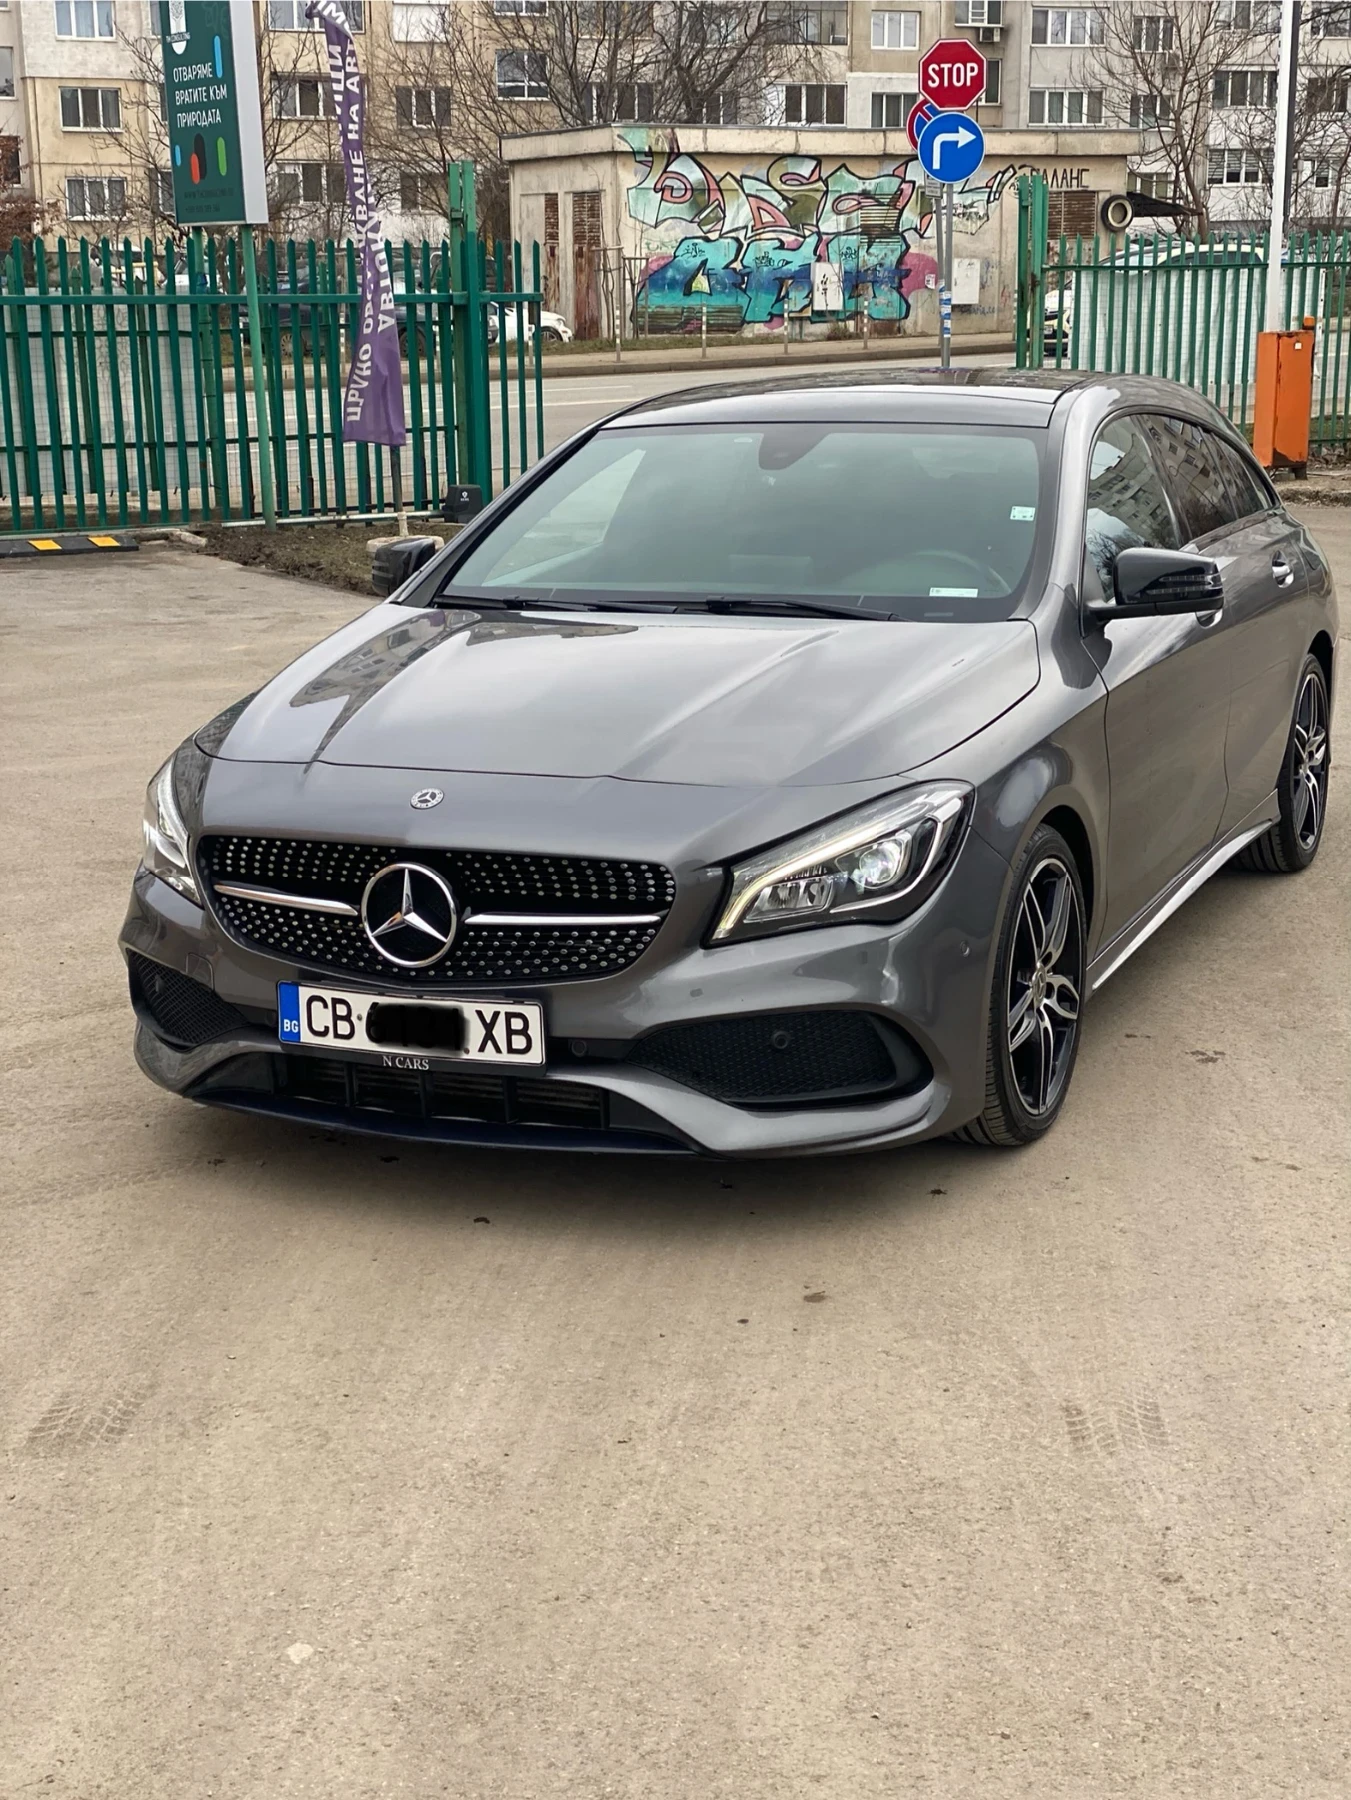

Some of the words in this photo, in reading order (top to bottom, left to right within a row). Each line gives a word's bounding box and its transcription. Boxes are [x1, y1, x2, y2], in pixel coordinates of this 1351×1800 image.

[173, 62, 213, 83] ОТВАРЯМЕ
[927, 62, 979, 88] STOP
[175, 86, 208, 105] ВРАТИТЕ
[209, 84, 228, 100] КЪМ
[176, 108, 222, 128] ПРИРОДАТА
[283, 1018, 299, 1034] BG
[305, 994, 356, 1041] CB
[474, 1009, 533, 1055] XB
[382, 1055, 392, 1067] N
[395, 1056, 430, 1070] CARS
